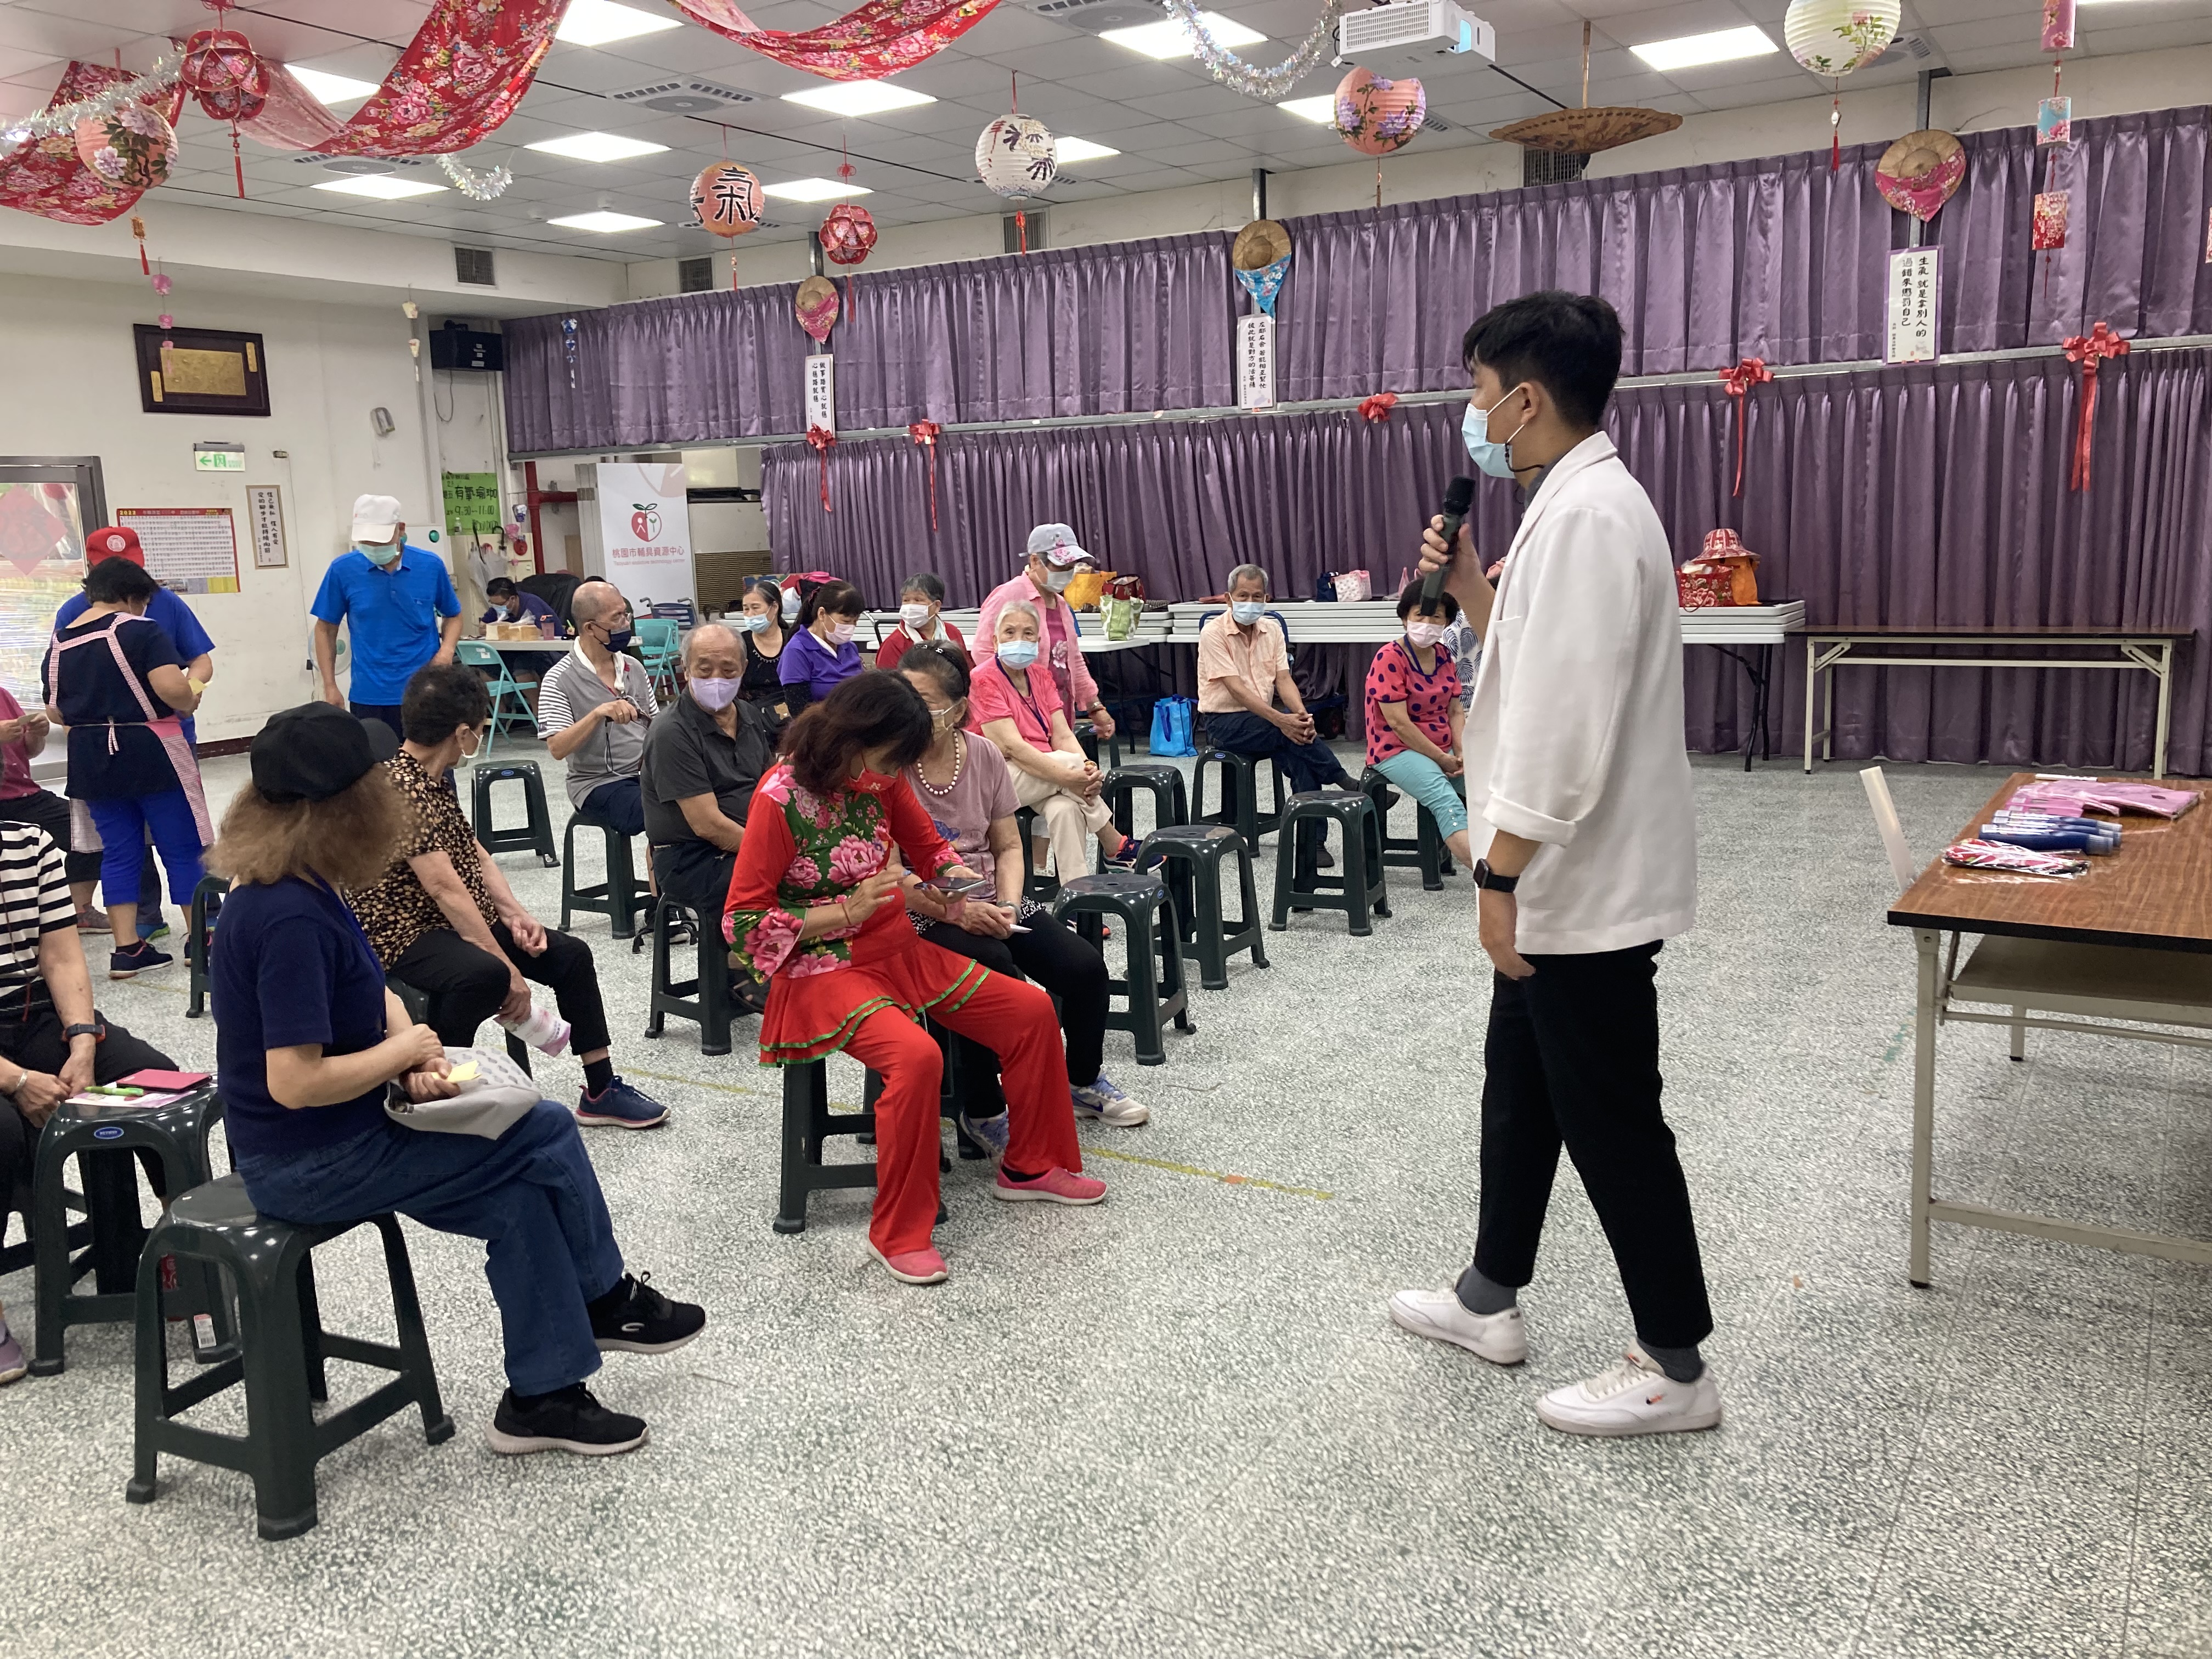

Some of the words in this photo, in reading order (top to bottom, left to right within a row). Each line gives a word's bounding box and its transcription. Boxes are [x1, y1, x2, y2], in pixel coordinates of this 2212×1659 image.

[612, 546, 685, 558] 桃園市輔具資源中心
